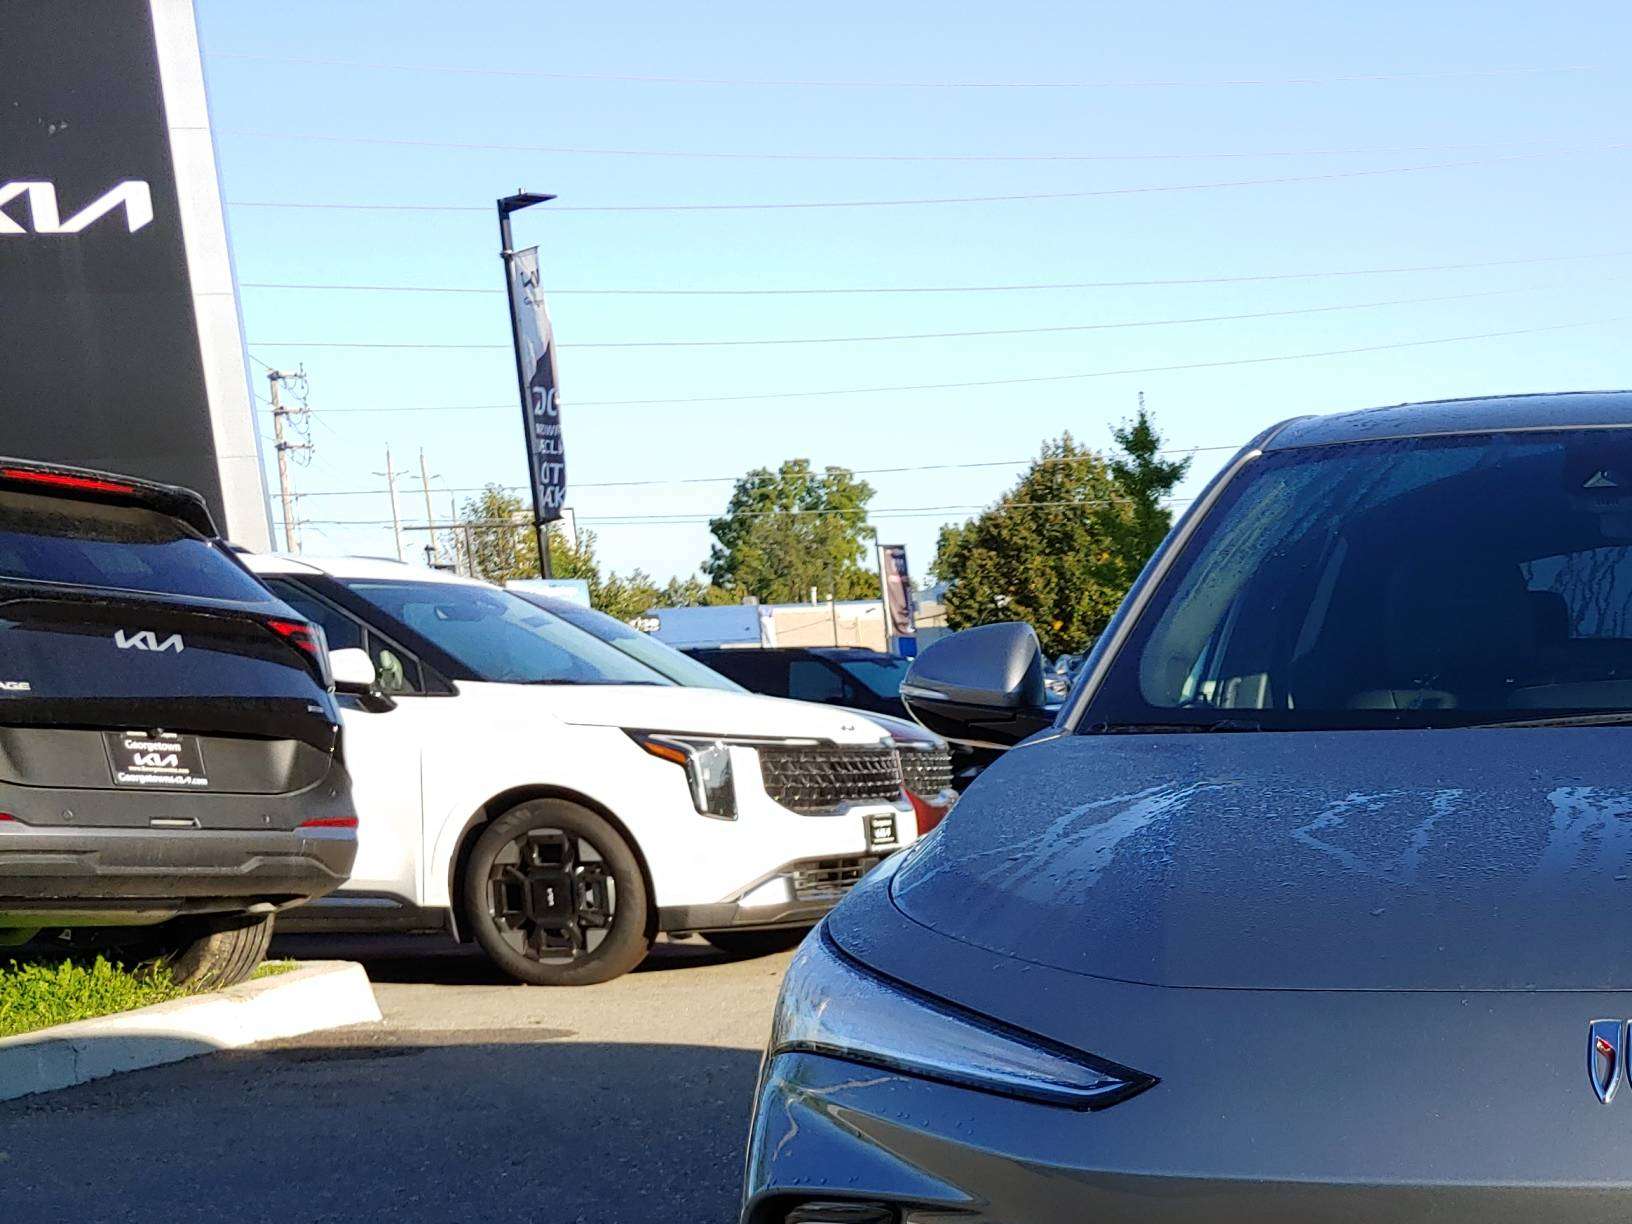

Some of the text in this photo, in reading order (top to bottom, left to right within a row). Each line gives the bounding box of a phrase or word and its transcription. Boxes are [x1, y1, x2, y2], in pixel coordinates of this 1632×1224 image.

[114, 629, 185, 653] KIA
[124, 740, 182, 752] Georgetown
[133, 752, 179, 767] KIA
